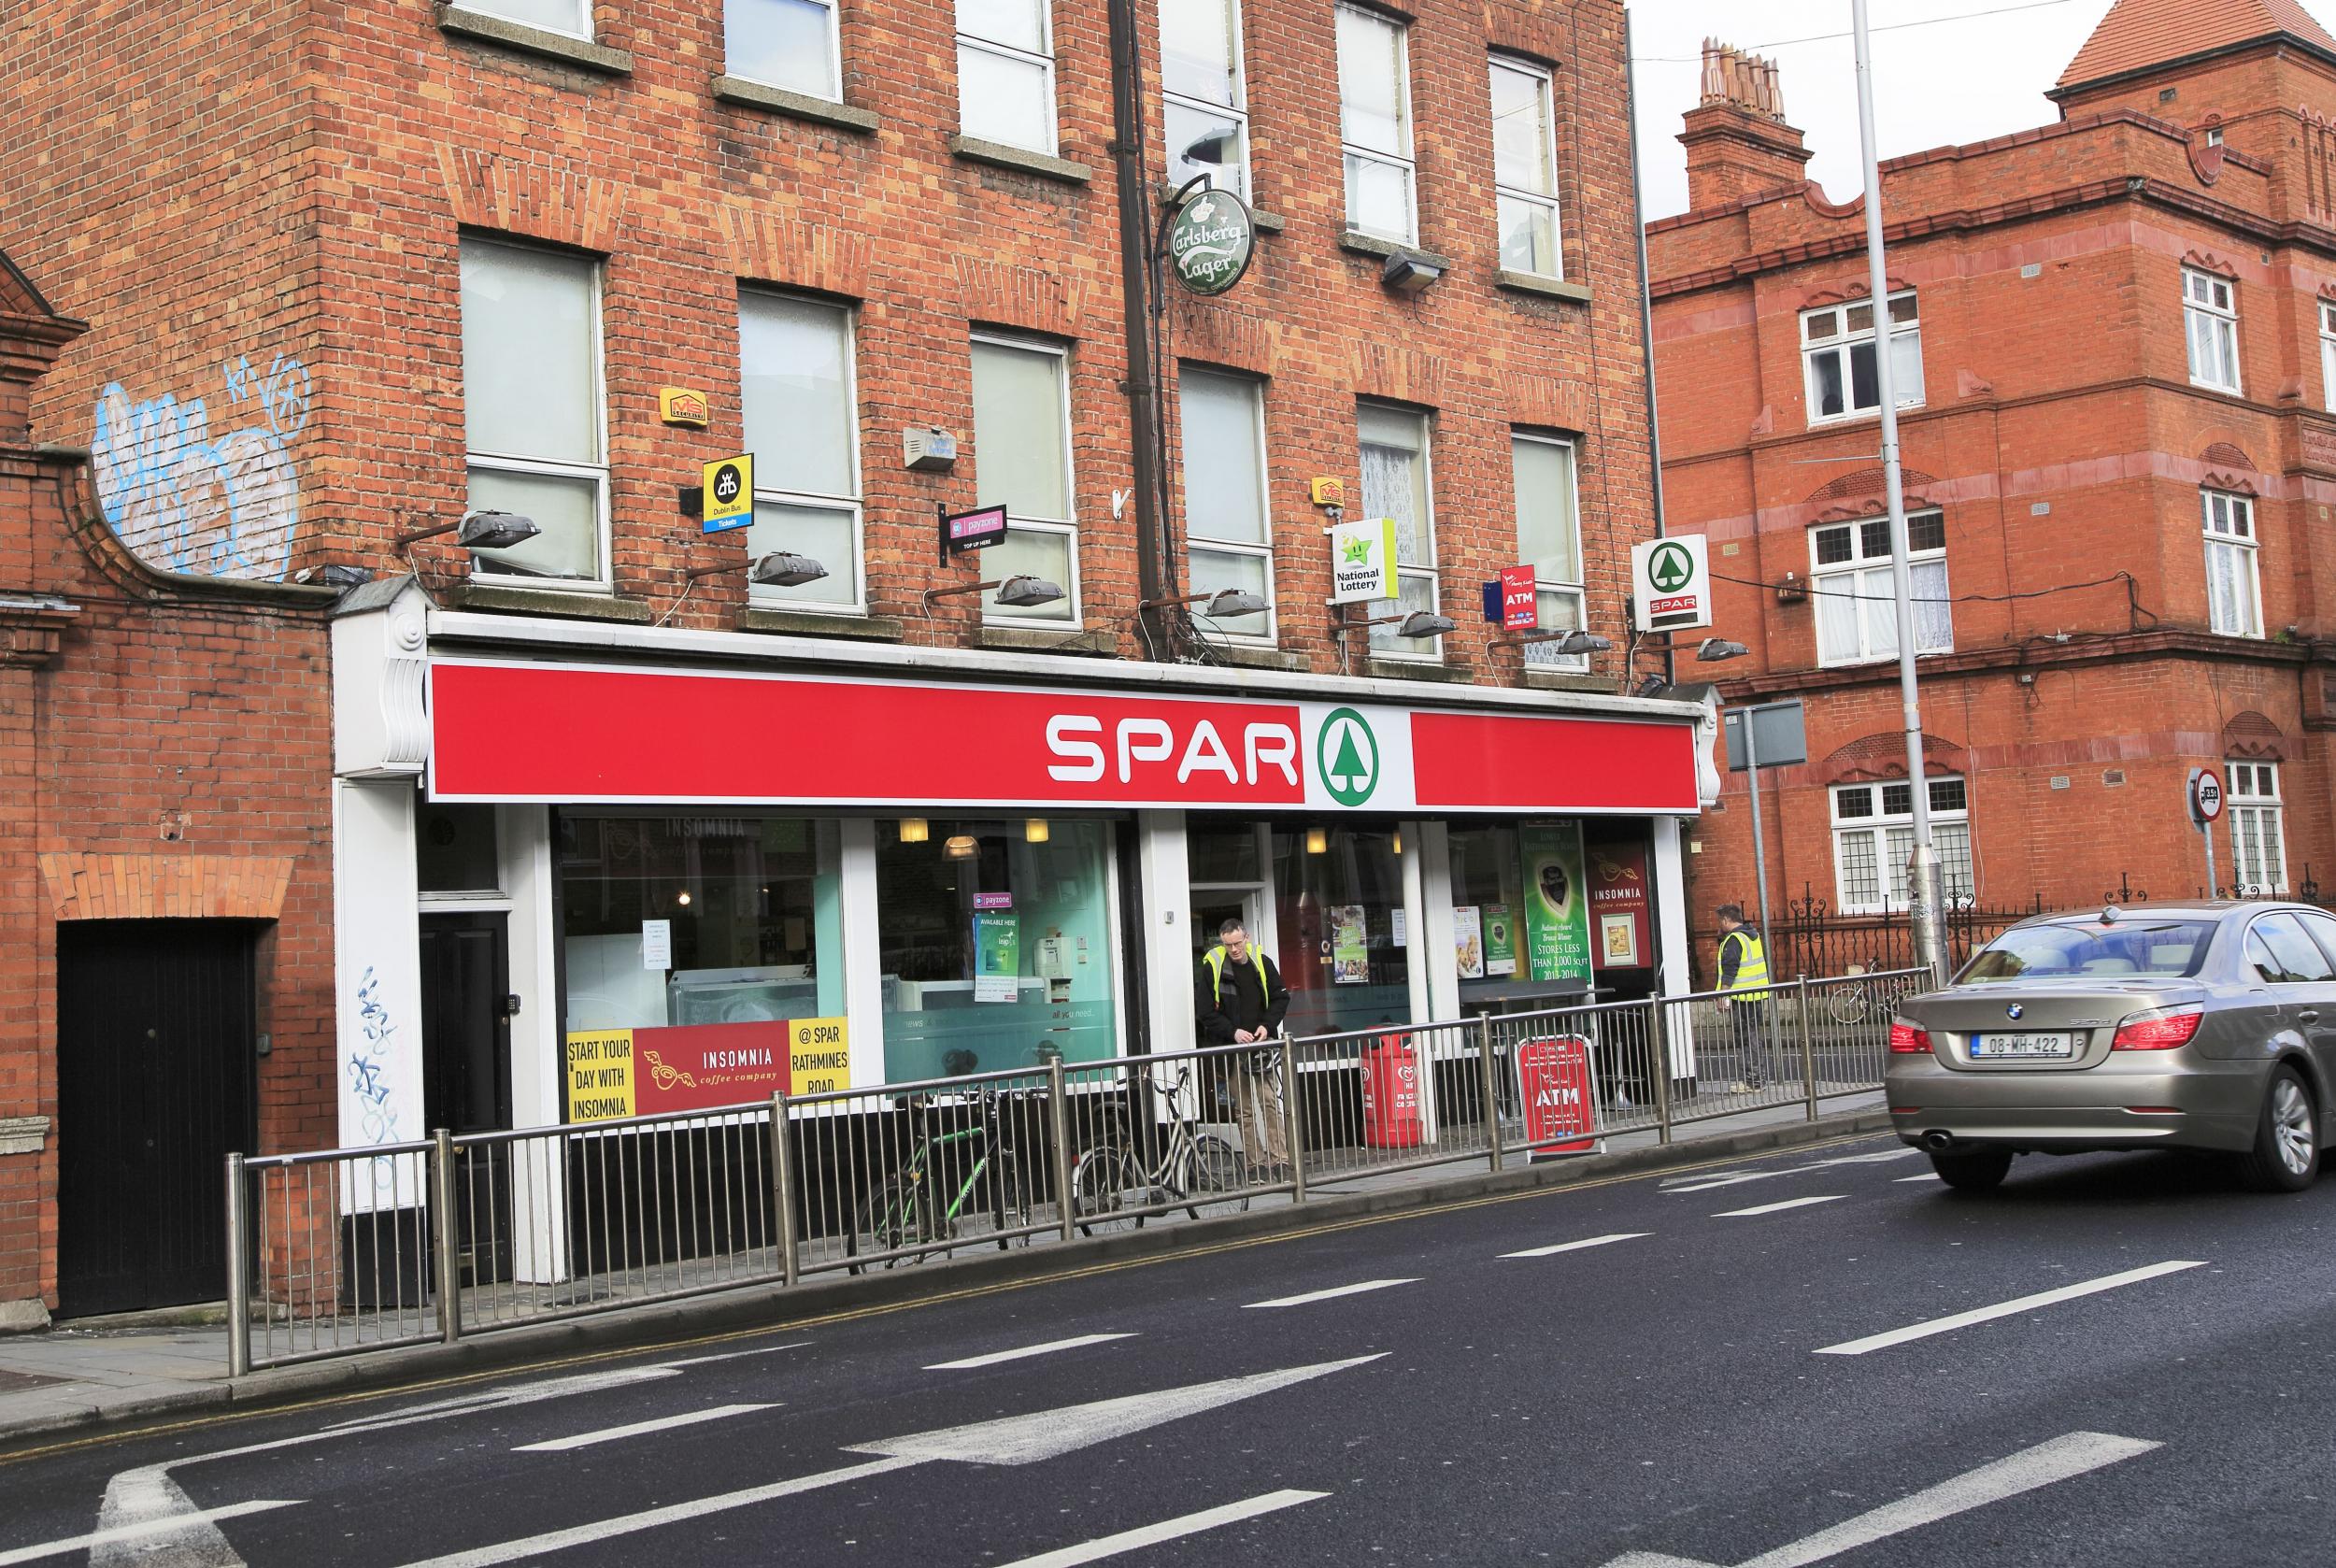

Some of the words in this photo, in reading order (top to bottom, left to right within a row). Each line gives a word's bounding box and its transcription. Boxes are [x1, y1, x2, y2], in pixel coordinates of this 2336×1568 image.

[1173, 217, 1242, 256] Carlsberg
[1183, 255, 1232, 282] Lager
[713, 506, 730, 516] Dublin
[731, 505, 742, 513] Bus
[718, 519, 737, 528] Tickets
[968, 516, 998, 534] payzone
[1337, 568, 1380, 581] National
[1341, 579, 1377, 592] Lottery
[1506, 592, 1533, 606] ATM
[1651, 598, 1696, 612] SPAR
[1046, 714, 1298, 786] SPAR
[985, 895, 1010, 905] payzone
[1594, 888, 1642, 900] INSOMNIA
[1593, 901, 1614, 909] coffee
[1537, 944, 1563, 955] STORES
[1564, 943, 1580, 953] LESS
[1532, 958, 1552, 968] THAN
[1544, 969, 1578, 981] 2013-2014
[1052, 1010, 1061, 1019] all
[1061, 1010, 1074, 1020] you
[799, 1028, 811, 1044] @
[814, 1026, 839, 1044] SPAR
[568, 1041, 599, 1062] START
[603, 1039, 631, 1059] YOUR
[1989, 1037, 2058, 1053] 08-MH-422
[703, 1048, 773, 1070] INSOMNIA
[791, 1051, 848, 1072] RATHMINES
[576, 1070, 595, 1090] DAY
[598, 1068, 624, 1088] WITH
[700, 1074, 732, 1086] coffee
[734, 1072, 777, 1083] company
[807, 1078, 834, 1094] ROAD
[1535, 1088, 1580, 1106] ATM
[574, 1097, 626, 1119] INSOMNIA
